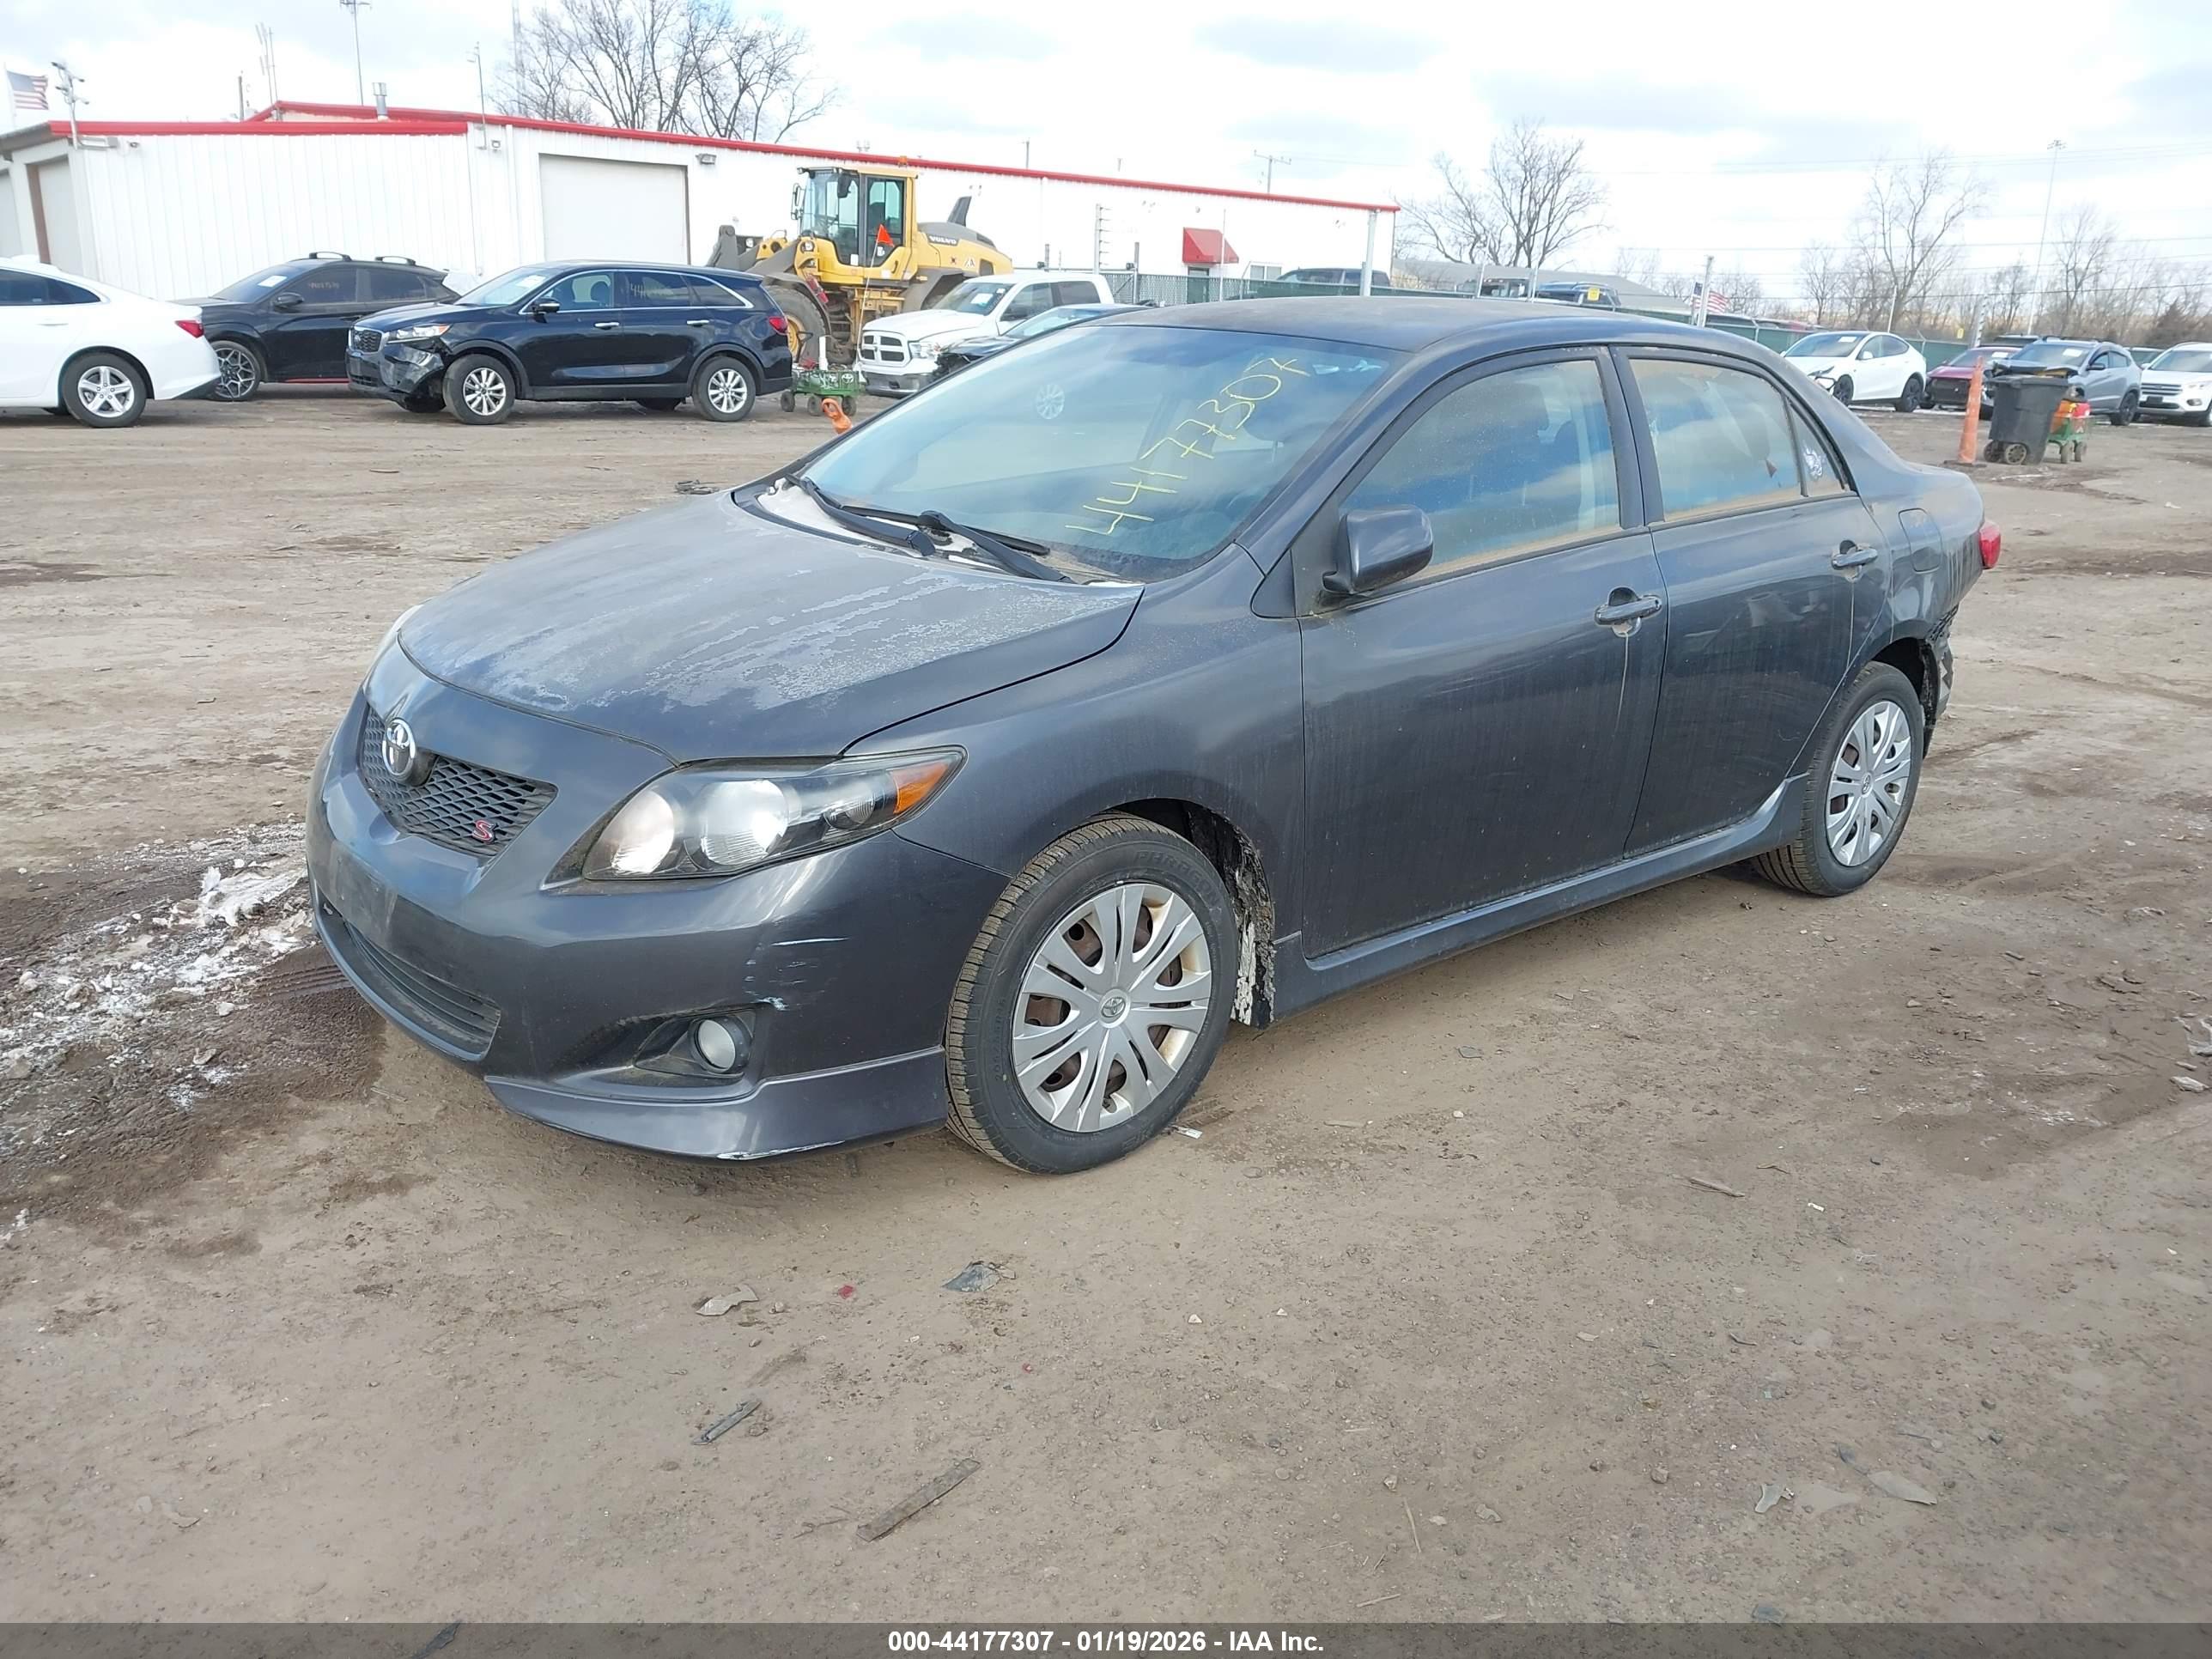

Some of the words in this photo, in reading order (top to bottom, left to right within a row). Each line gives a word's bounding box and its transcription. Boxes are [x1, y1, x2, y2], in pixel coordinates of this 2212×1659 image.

[928, 235, 957, 245] VOLVO
[1065, 357, 1310, 535] 44177307
[471, 820, 495, 843] S
